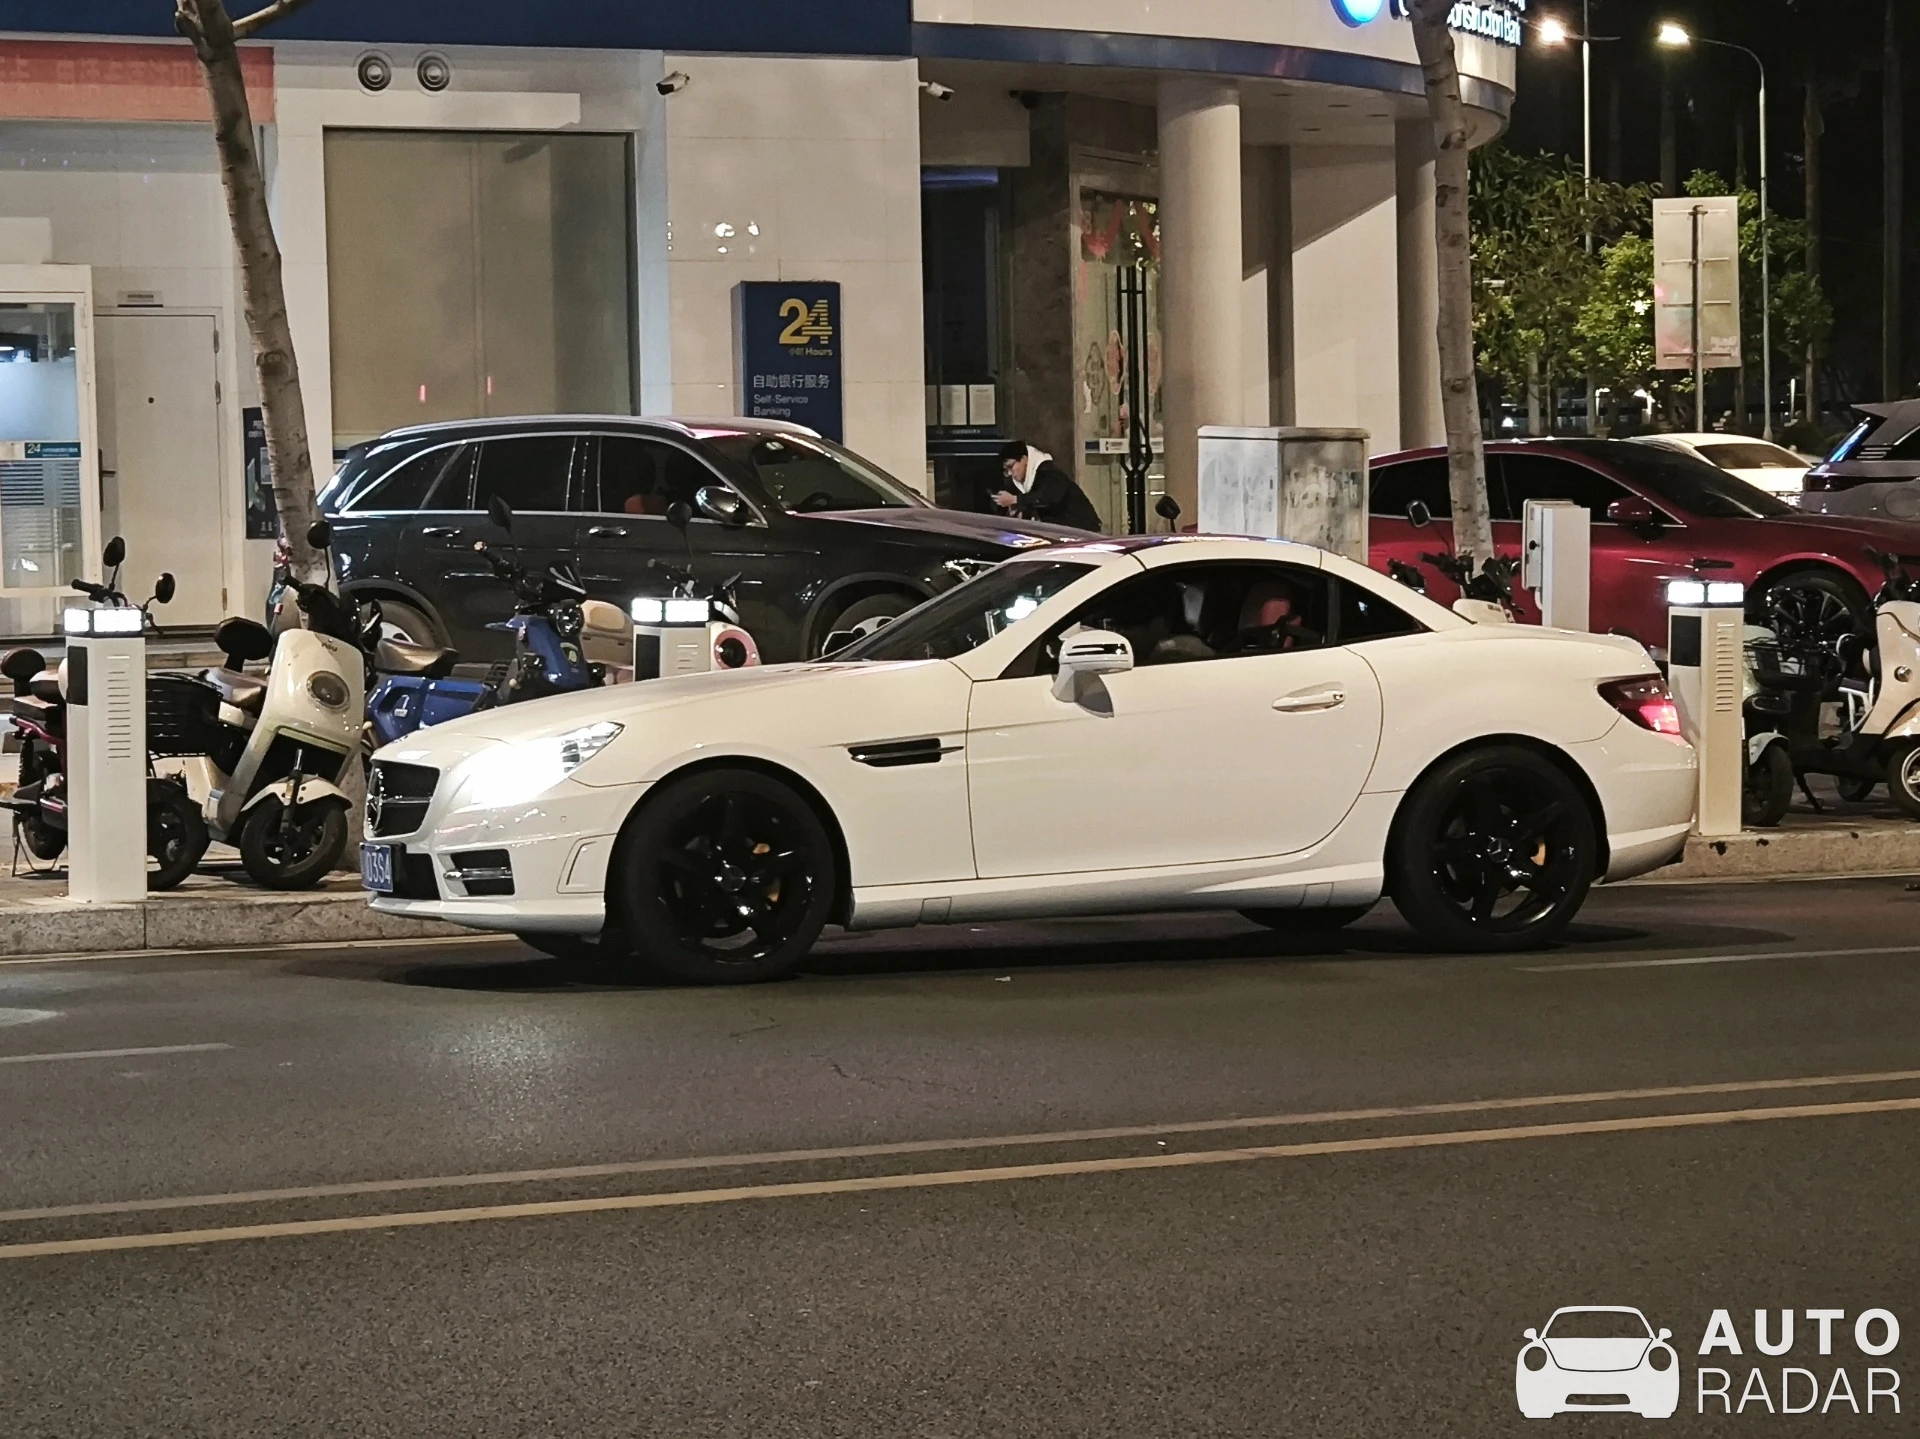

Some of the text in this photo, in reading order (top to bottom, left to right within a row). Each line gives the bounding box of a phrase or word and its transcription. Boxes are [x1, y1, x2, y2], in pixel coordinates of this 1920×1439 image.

[1447, 1, 1504, 38] onstruction
[778, 298, 833, 345] 24
[805, 347, 833, 356] Hours
[753, 374, 831, 389] 自助银行服务
[753, 394, 809, 404] Self-Service
[753, 406, 791, 417] Banking
[27, 443, 41, 454] 24
